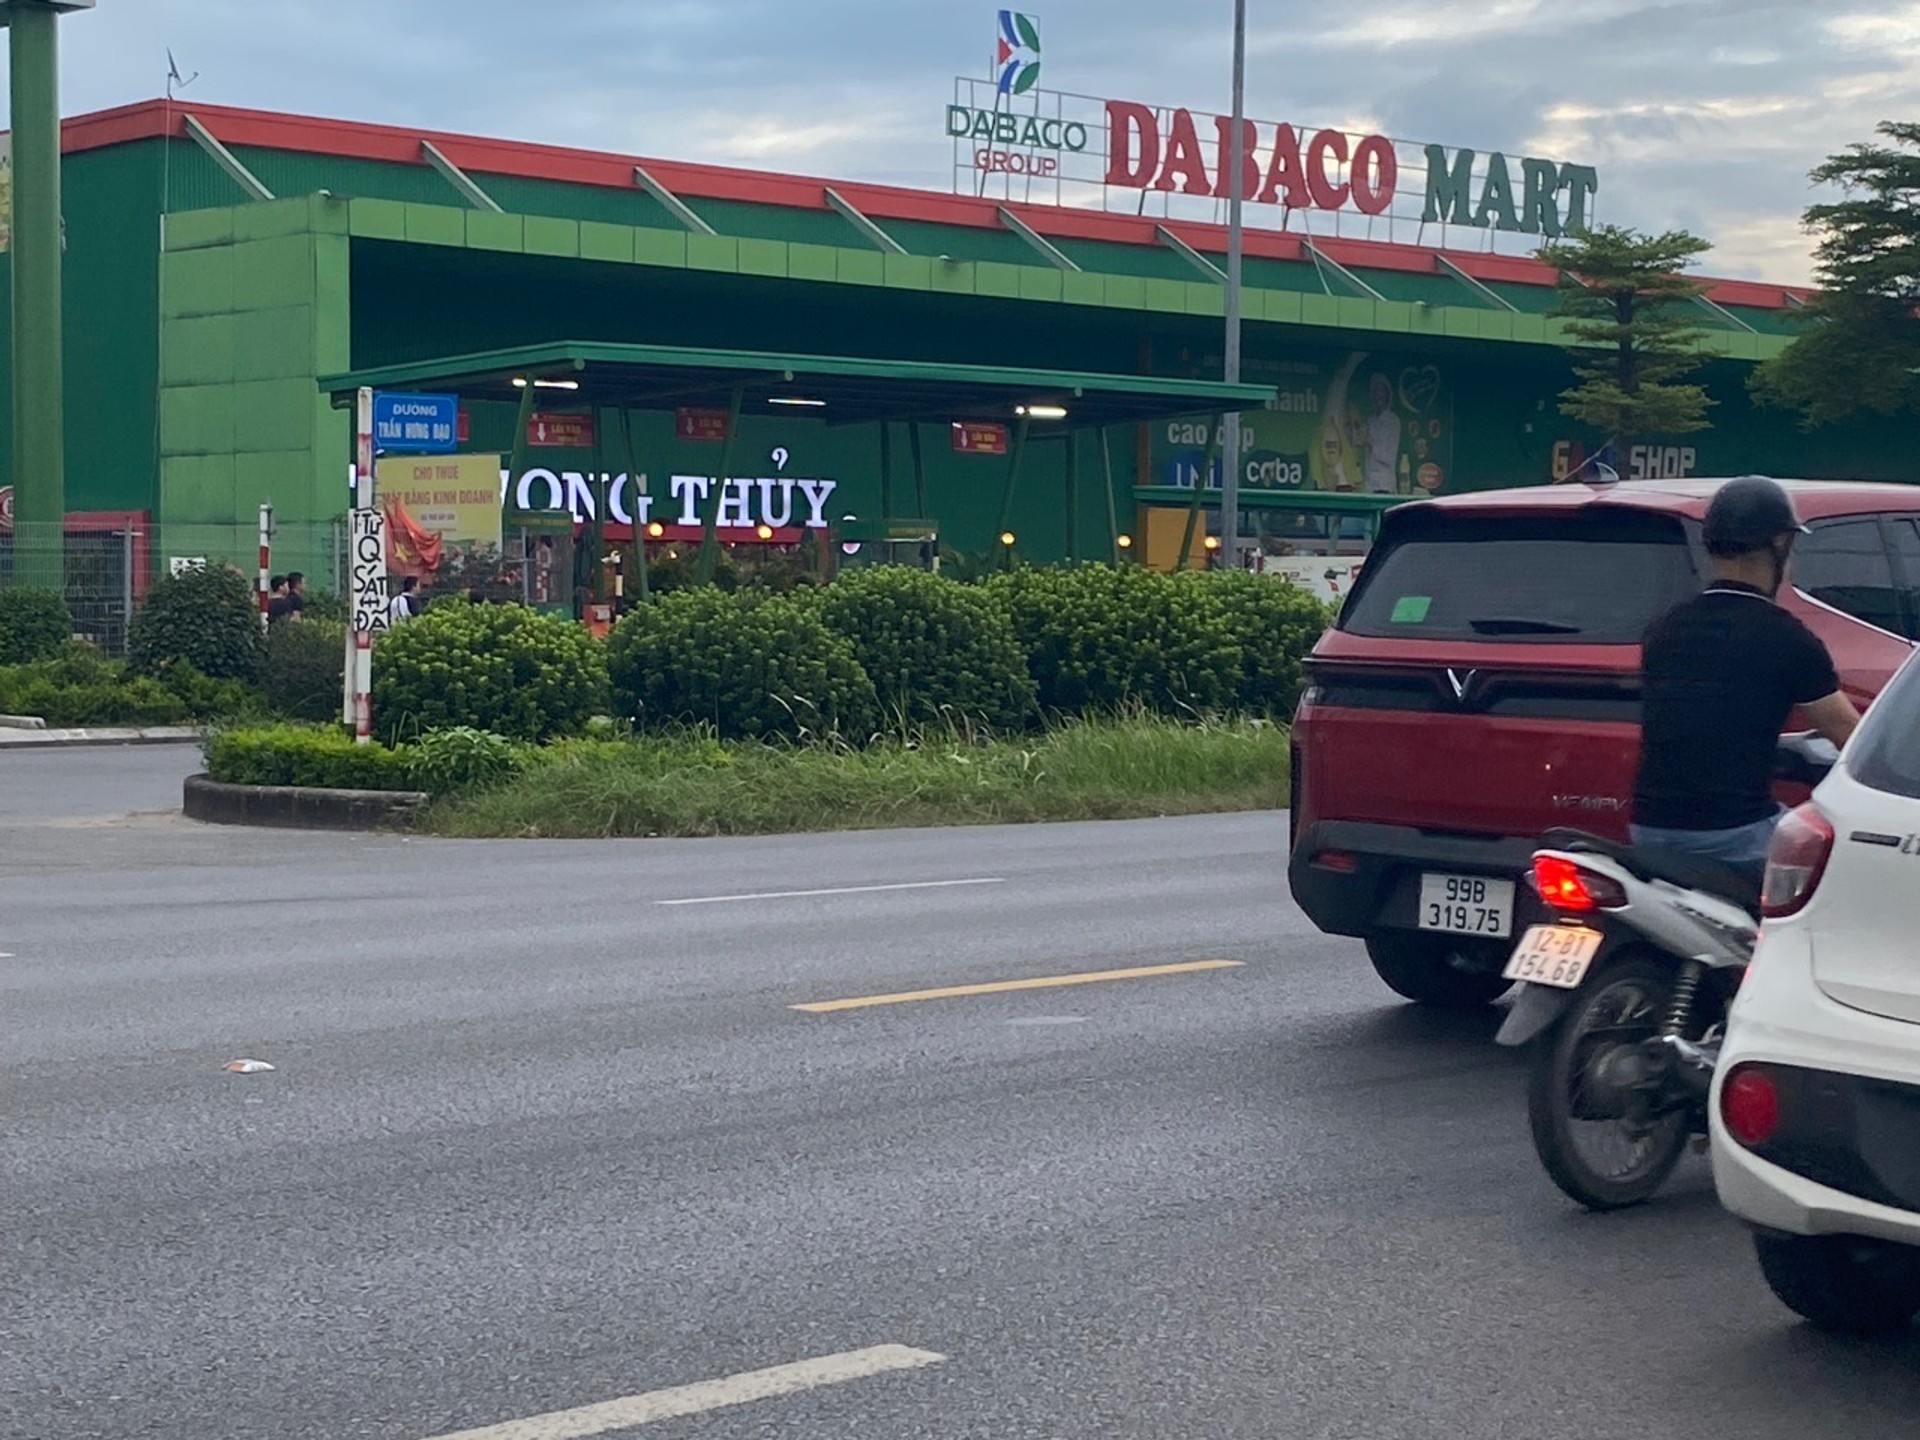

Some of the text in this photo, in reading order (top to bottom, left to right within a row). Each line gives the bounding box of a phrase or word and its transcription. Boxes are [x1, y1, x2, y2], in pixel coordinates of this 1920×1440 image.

[946, 104, 1087, 151] DABACO
[975, 149, 1057, 176] GROUP
[1105, 99, 1599, 239] DABACO MART
[1168, 422, 1207, 445] cao
[413, 466, 433, 480] CHO
[1629, 445, 1697, 480] SHOP
[433, 490, 457, 505] KINH
[459, 489, 494, 505] DOANH
[670, 446, 837, 528] THỦY
[1445, 878, 1486, 903] 99B
[1428, 902, 1501, 933] 319.75
